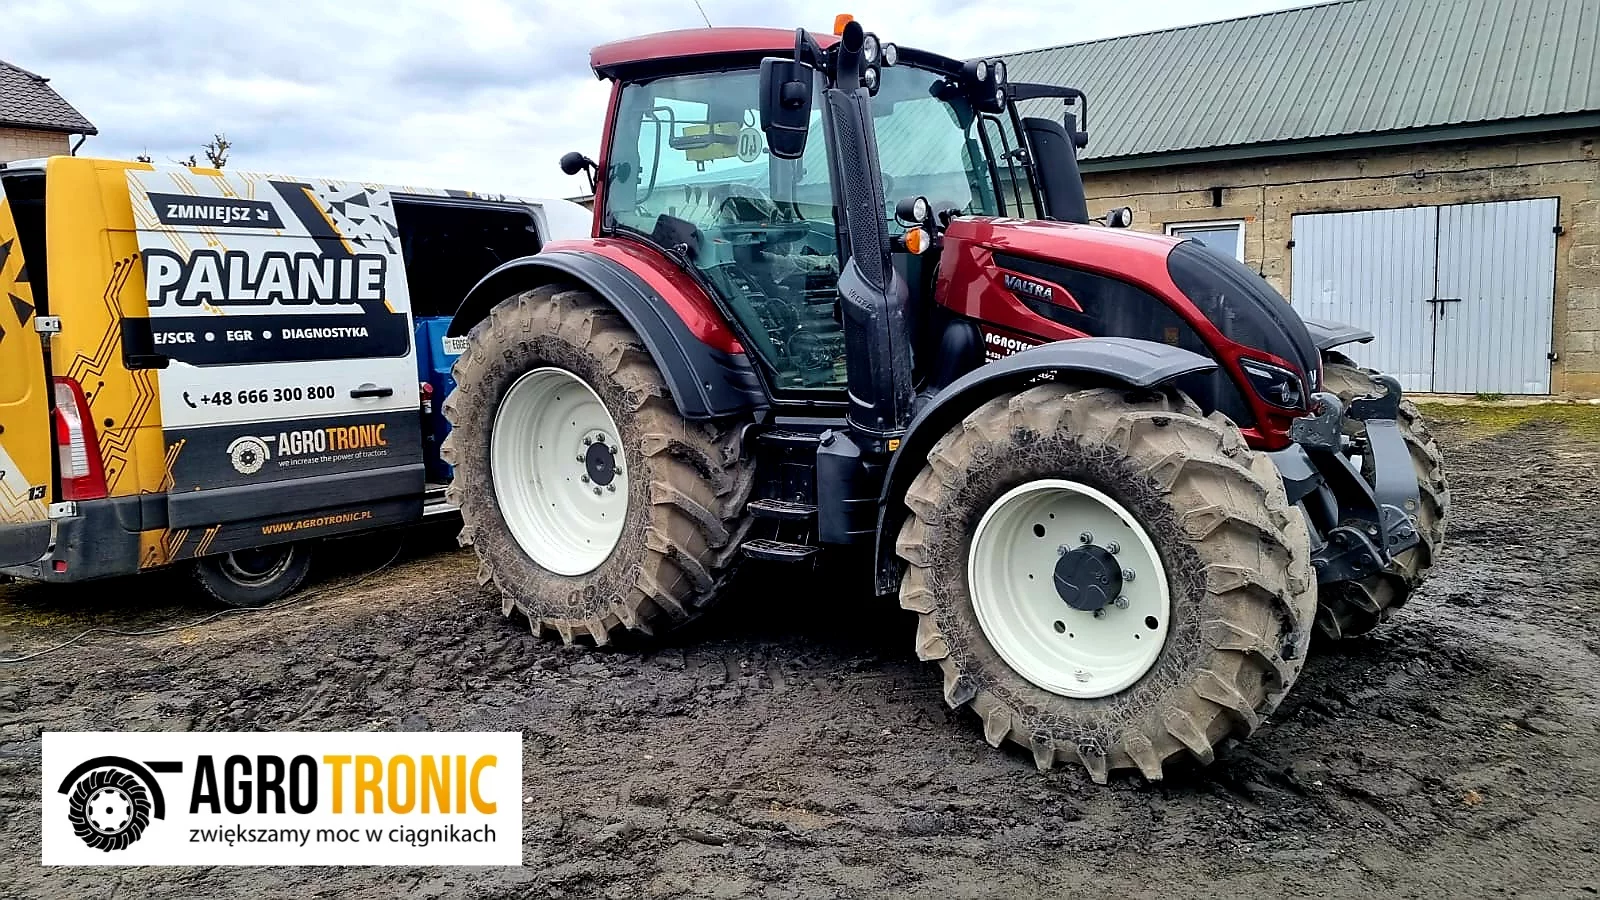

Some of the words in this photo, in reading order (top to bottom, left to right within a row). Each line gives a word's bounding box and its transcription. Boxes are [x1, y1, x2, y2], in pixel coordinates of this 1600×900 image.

[167, 204, 251, 224] ZMNIEJSZ
[145, 252, 384, 304] PALANIE
[1004, 274, 1052, 300] VALTRA
[153, 332, 196, 344] E/SCR
[226, 330, 254, 342] EGR
[282, 327, 369, 340] DIAGNOSTYKA
[200, 391, 233, 406] +48
[237, 389, 268, 404] 666
[273, 387, 302, 403] 300
[307, 385, 335, 401] 800
[278, 424, 387, 456] AGROTRONIC
[278, 459, 290, 467] we
[289, 457, 319, 466] increase
[320, 455, 332, 463] the
[333, 453, 355, 463] power
[355, 451, 362, 459] of
[362, 449, 388, 458] tractors
[28, 485, 47, 501] 13
[262, 511, 373, 535] WWW.AGROTRONIC.PL
